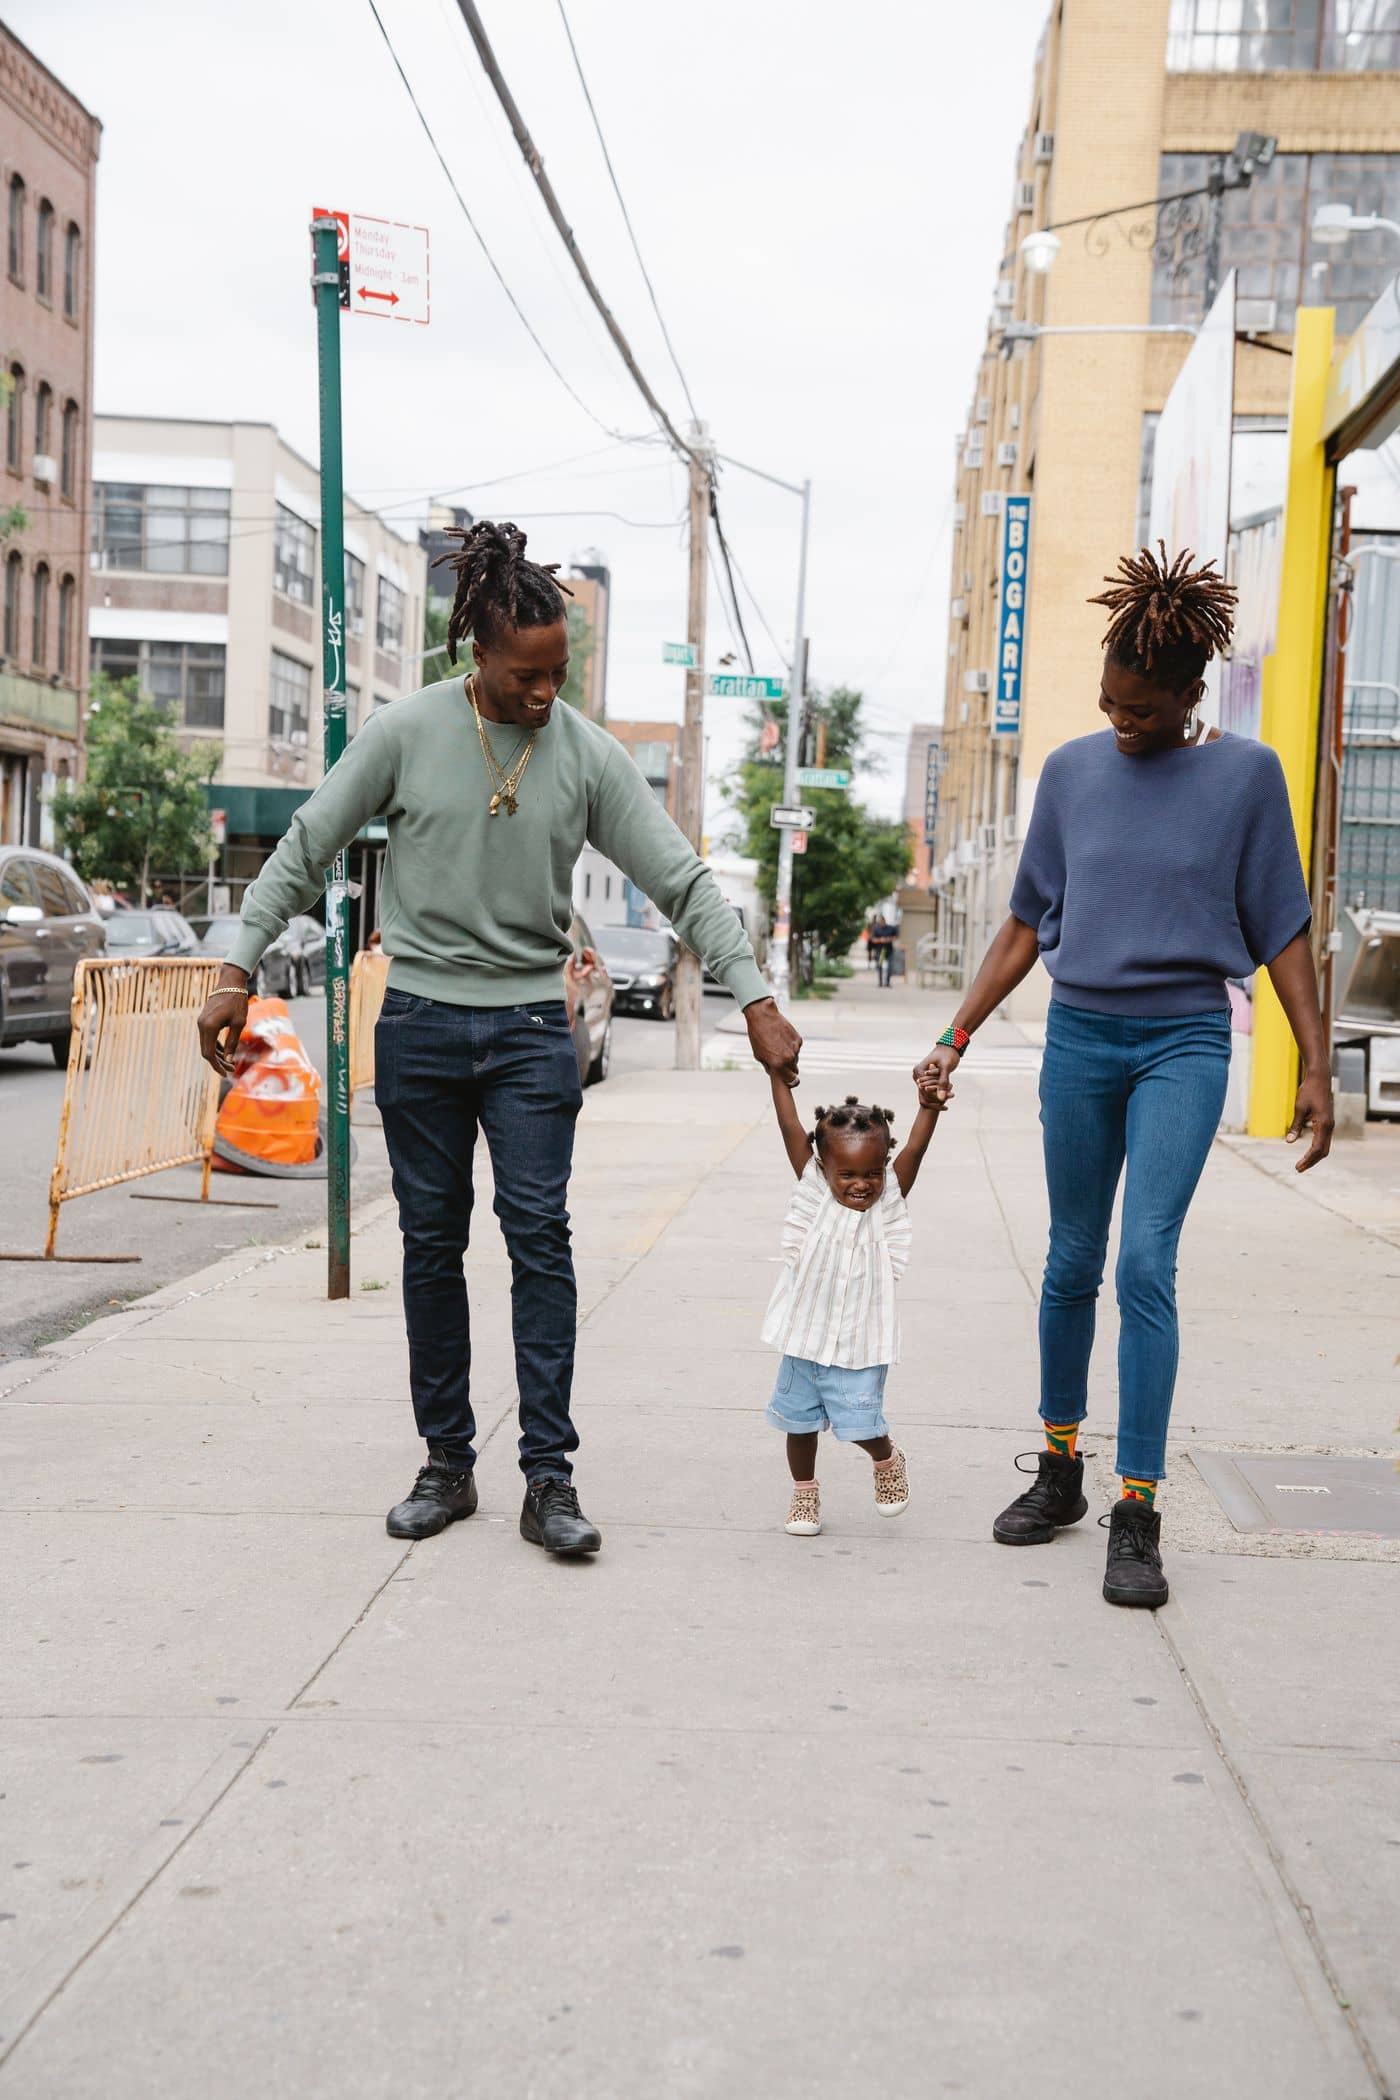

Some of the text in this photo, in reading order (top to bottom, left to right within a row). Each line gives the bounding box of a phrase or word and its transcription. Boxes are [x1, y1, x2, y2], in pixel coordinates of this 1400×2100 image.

[354, 227, 389, 247] Monday
[355, 240, 396, 262] Thursday
[1003, 521, 1024, 699] BOGART
